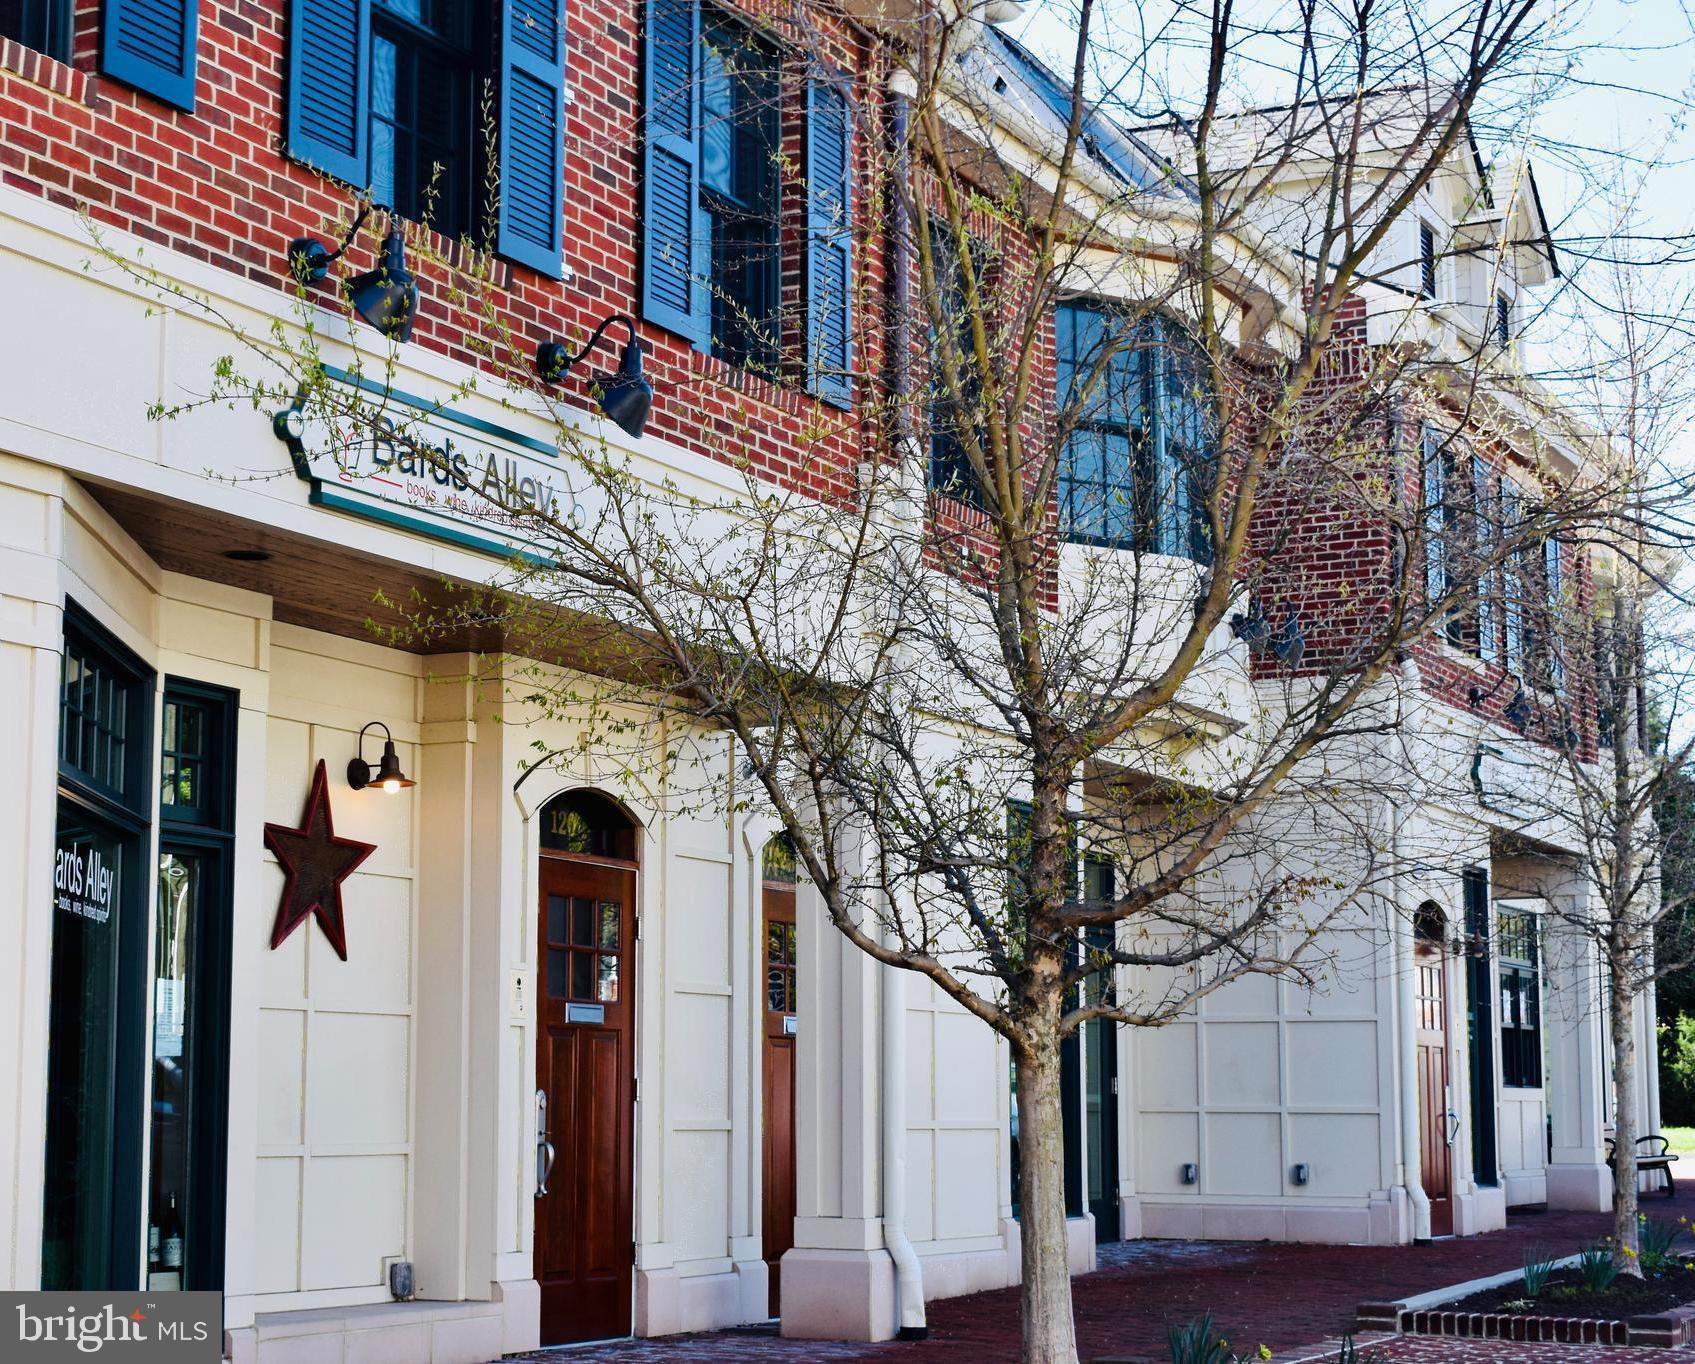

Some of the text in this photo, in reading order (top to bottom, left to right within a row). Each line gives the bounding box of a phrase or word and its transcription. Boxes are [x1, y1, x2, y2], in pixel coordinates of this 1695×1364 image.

[372, 415, 554, 531] Bards Alley
[55, 842, 114, 919] ards Alley
